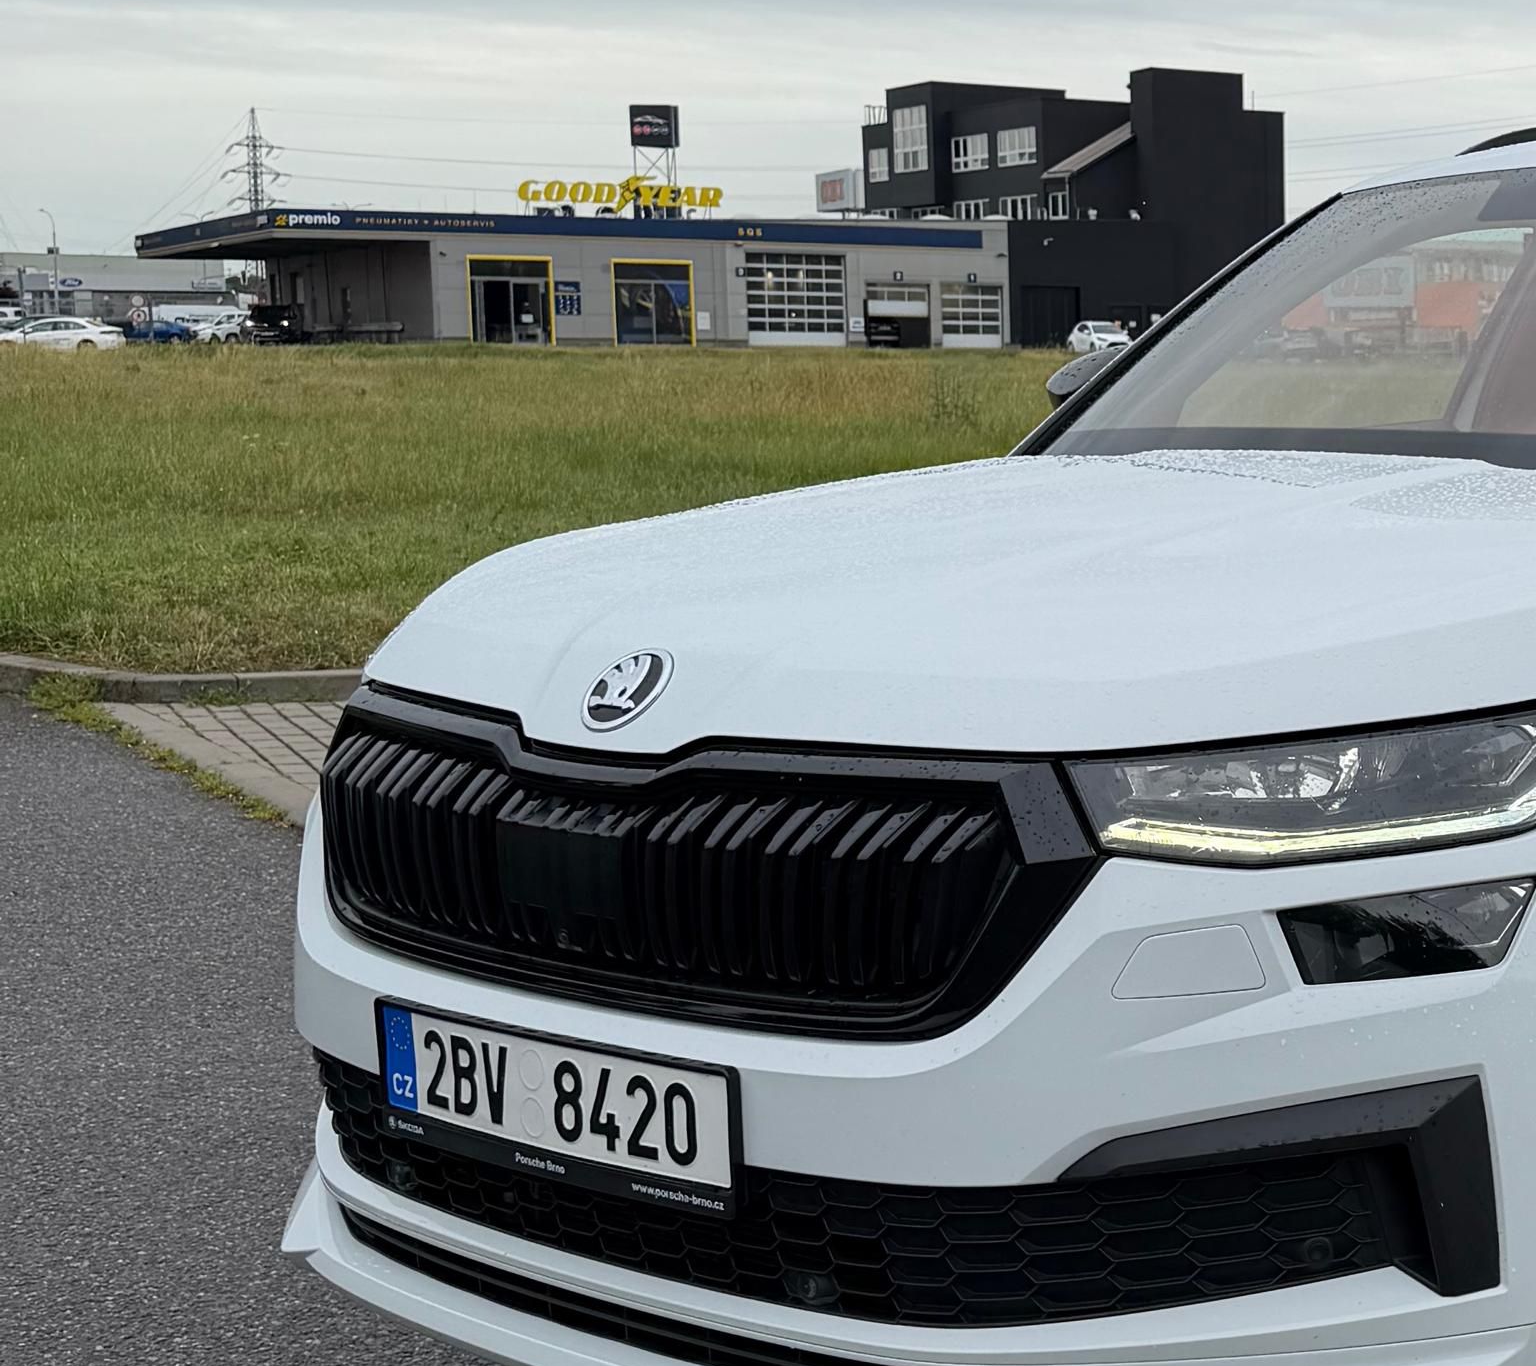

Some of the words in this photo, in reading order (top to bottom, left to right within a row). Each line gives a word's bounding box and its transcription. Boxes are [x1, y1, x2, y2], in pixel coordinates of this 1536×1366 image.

[518, 180, 723, 208] GOODYEAR
[289, 213, 341, 227] premio
[355, 217, 419, 226] PNEUMATIKY
[433, 219, 496, 228] AUTOSERVIS
[392, 1073, 414, 1099] CZ
[424, 1030, 508, 1126] 2BV
[554, 1060, 697, 1166] 8420
[515, 1152, 546, 1171] Porsche
[546, 1160, 566, 1175] Brno
[631, 1183, 725, 1211] www.porsche-brno.cz
